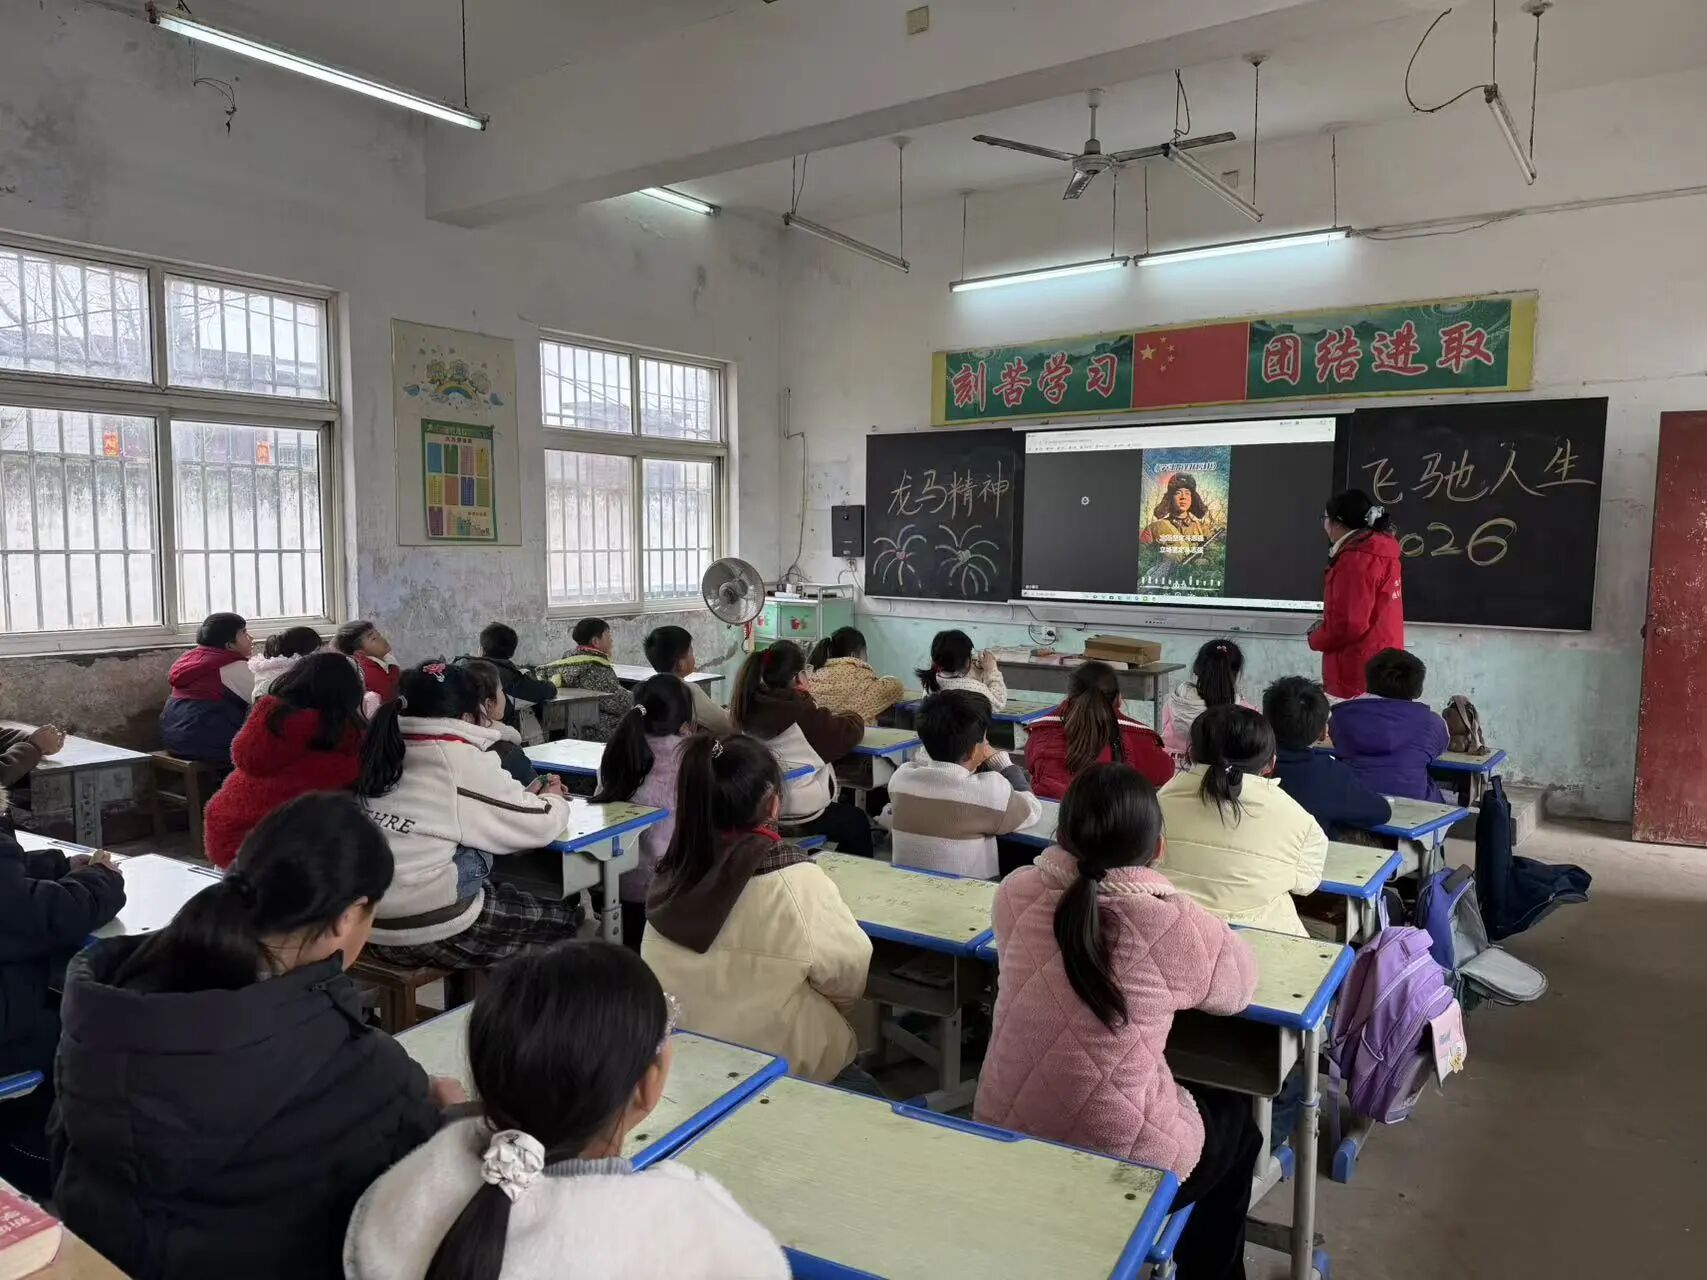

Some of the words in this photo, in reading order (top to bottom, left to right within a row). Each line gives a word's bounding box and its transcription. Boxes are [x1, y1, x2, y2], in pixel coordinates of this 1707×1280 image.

[952, 352, 1118, 412] 刻苦学习
[1262, 319, 1495, 386] 团结进取
[887, 460, 1010, 520] 龙马精神
[1361, 438, 1597, 505] 飞驰人生
